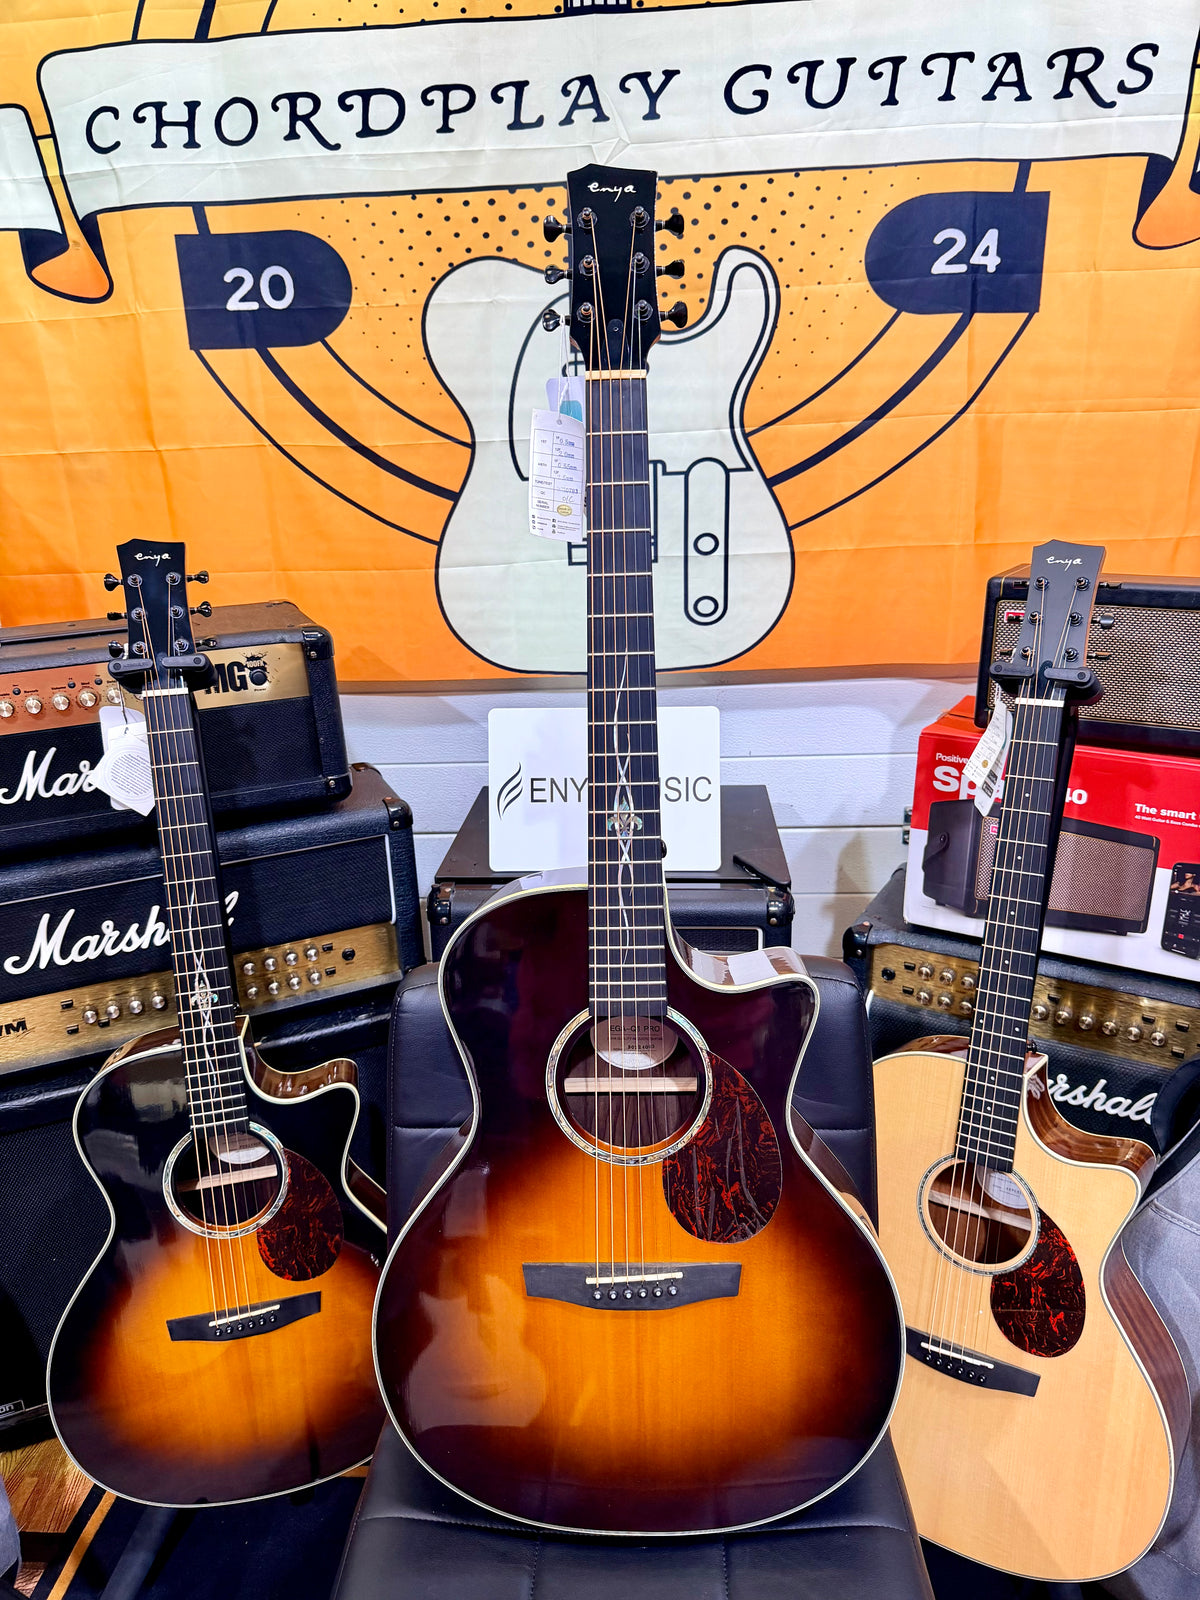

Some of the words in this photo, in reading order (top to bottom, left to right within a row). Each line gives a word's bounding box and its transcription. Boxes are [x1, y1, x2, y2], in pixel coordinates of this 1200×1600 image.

[86, 69, 680, 154] CHORDPLAY
[723, 43, 1160, 115] GUITARS
[587, 182, 637, 202] enya
[931, 228, 1001, 275] 24
[223, 265, 295, 312] 20
[134, 552, 171, 567] enya
[1046, 556, 1083, 571] enya
[935, 752, 969, 765] Positive
[530, 777, 588, 803] ENY
[659, 776, 712, 802] SIC
[1134, 803, 1157, 814] The
[1160, 809, 1196, 820] smart
[4, 891, 239, 975] Marsh
[1047, 1073, 1158, 1126] rshal
